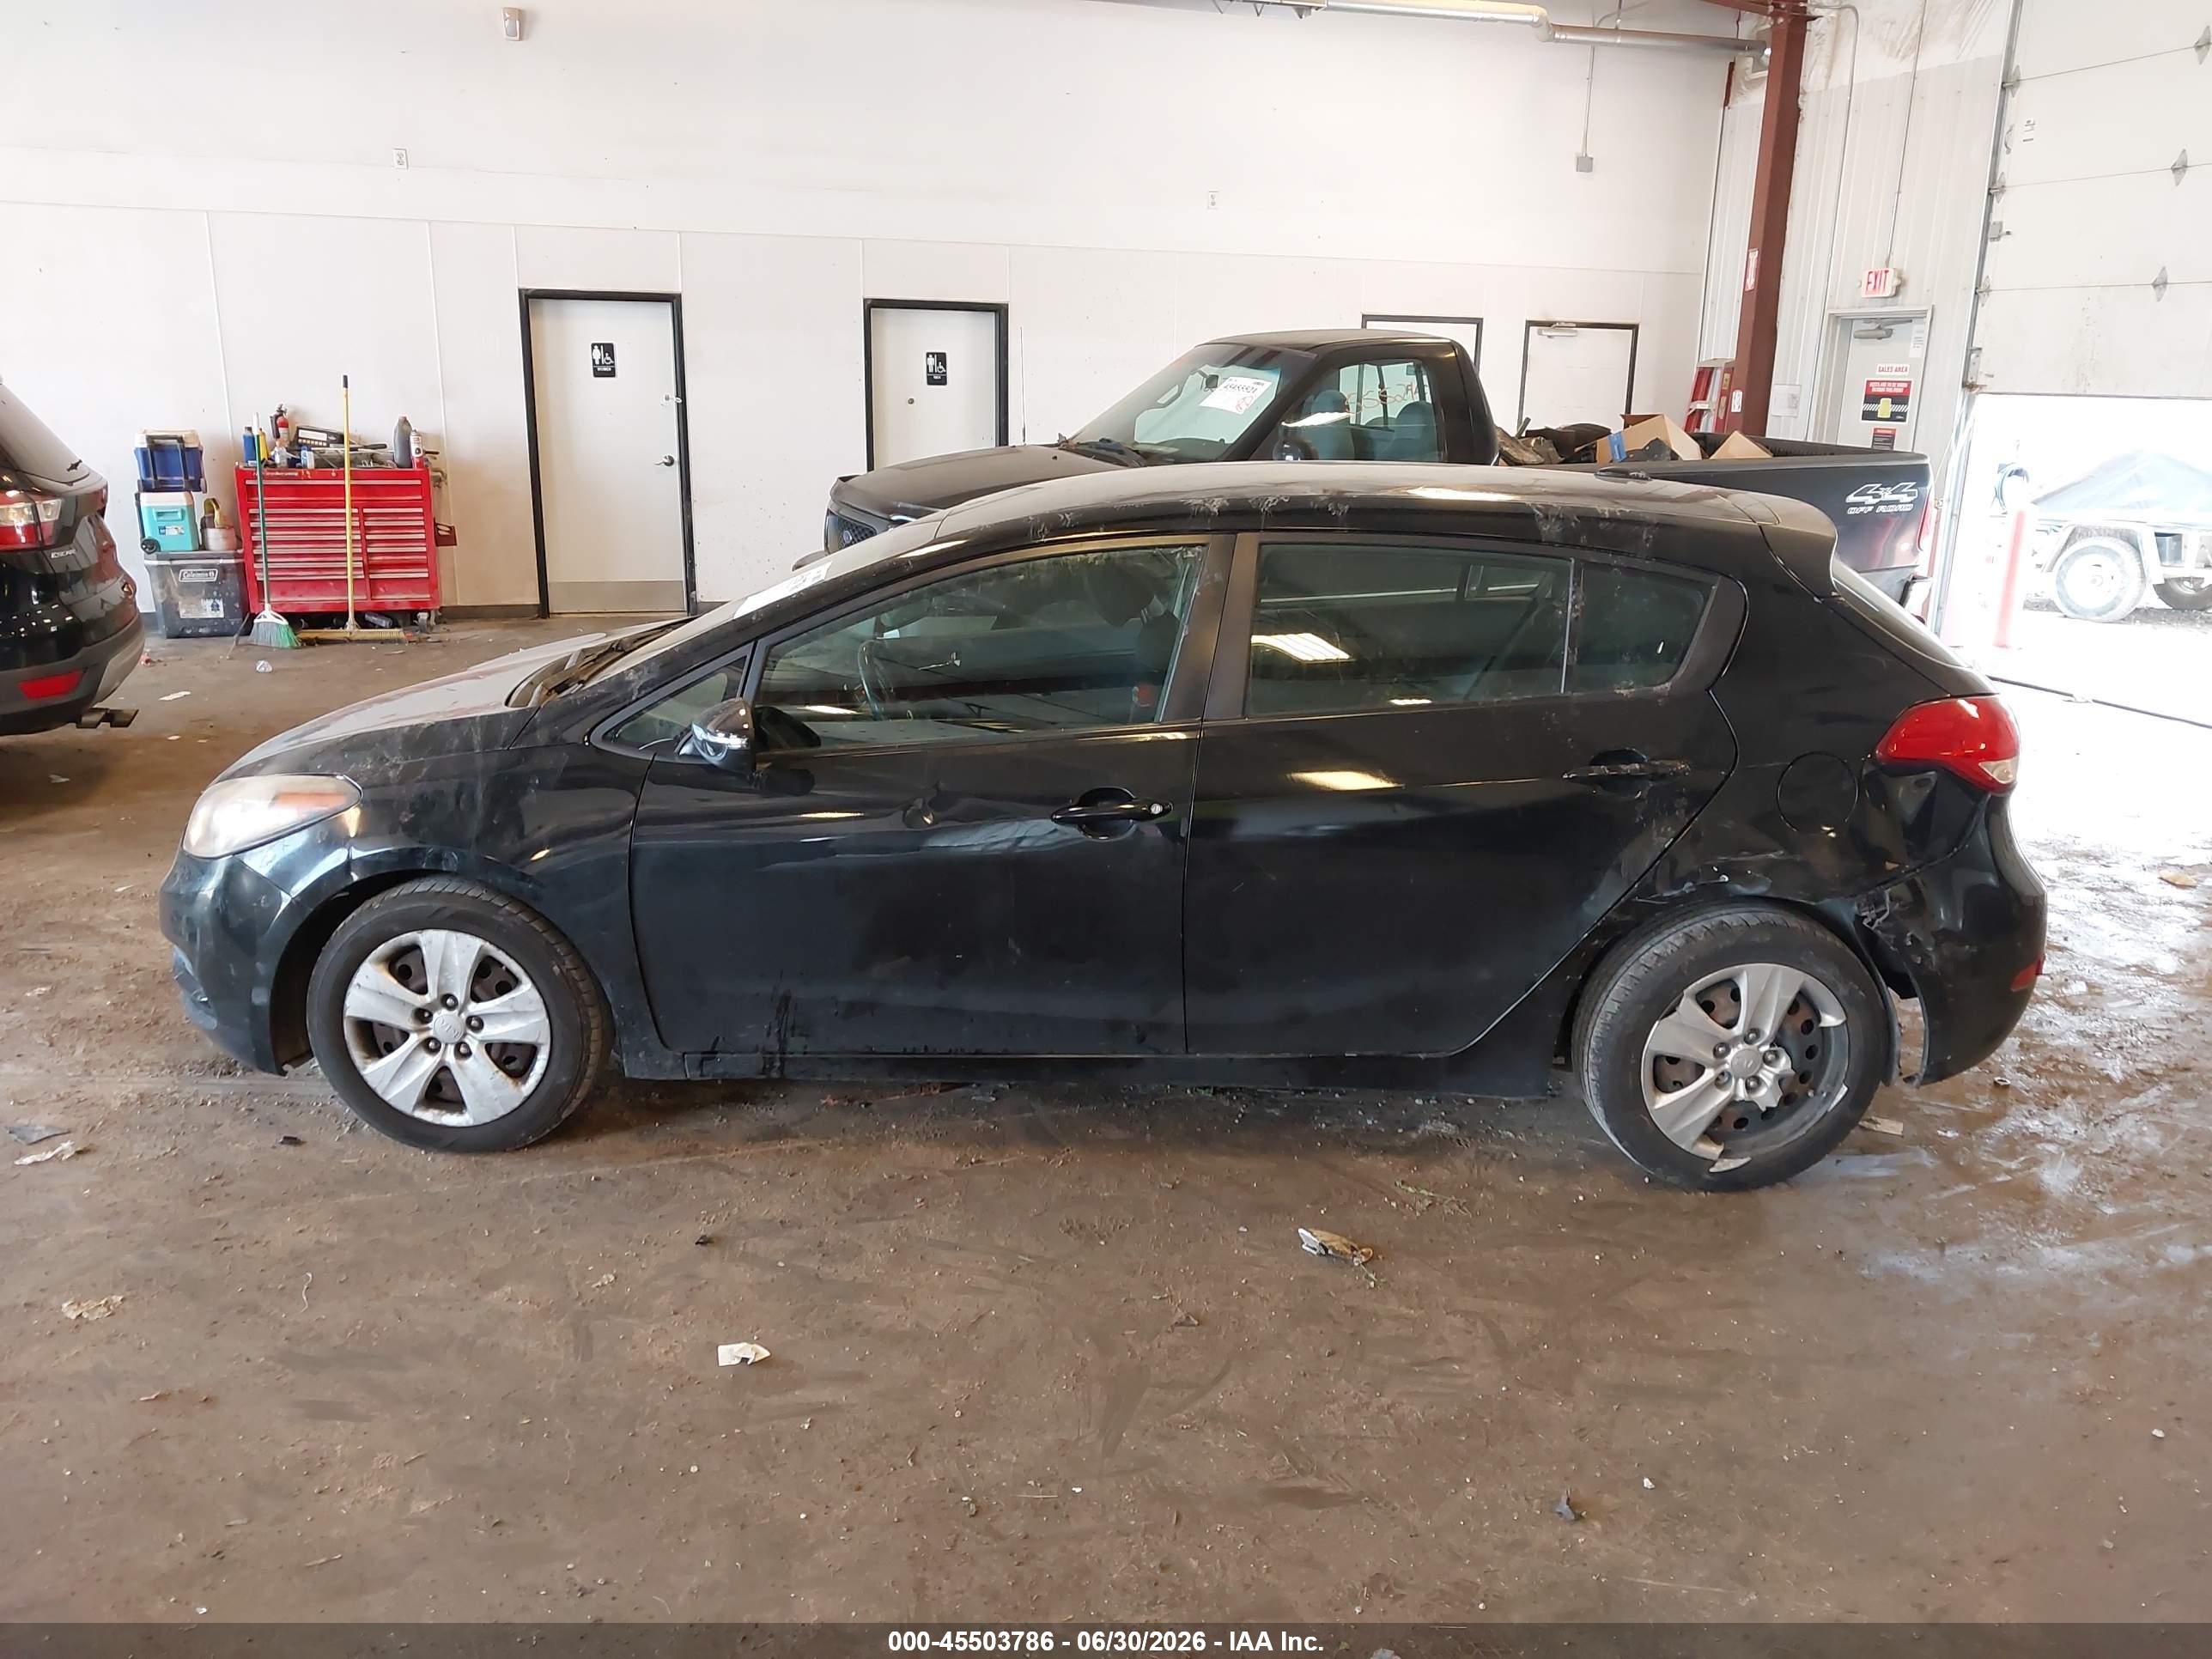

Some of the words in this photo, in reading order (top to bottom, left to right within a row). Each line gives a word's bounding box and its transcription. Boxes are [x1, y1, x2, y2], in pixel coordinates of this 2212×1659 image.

[1865, 270, 1889, 294] EXIT
[1847, 506, 1874, 514] OFF
[1875, 503, 1913, 514] ROAD
